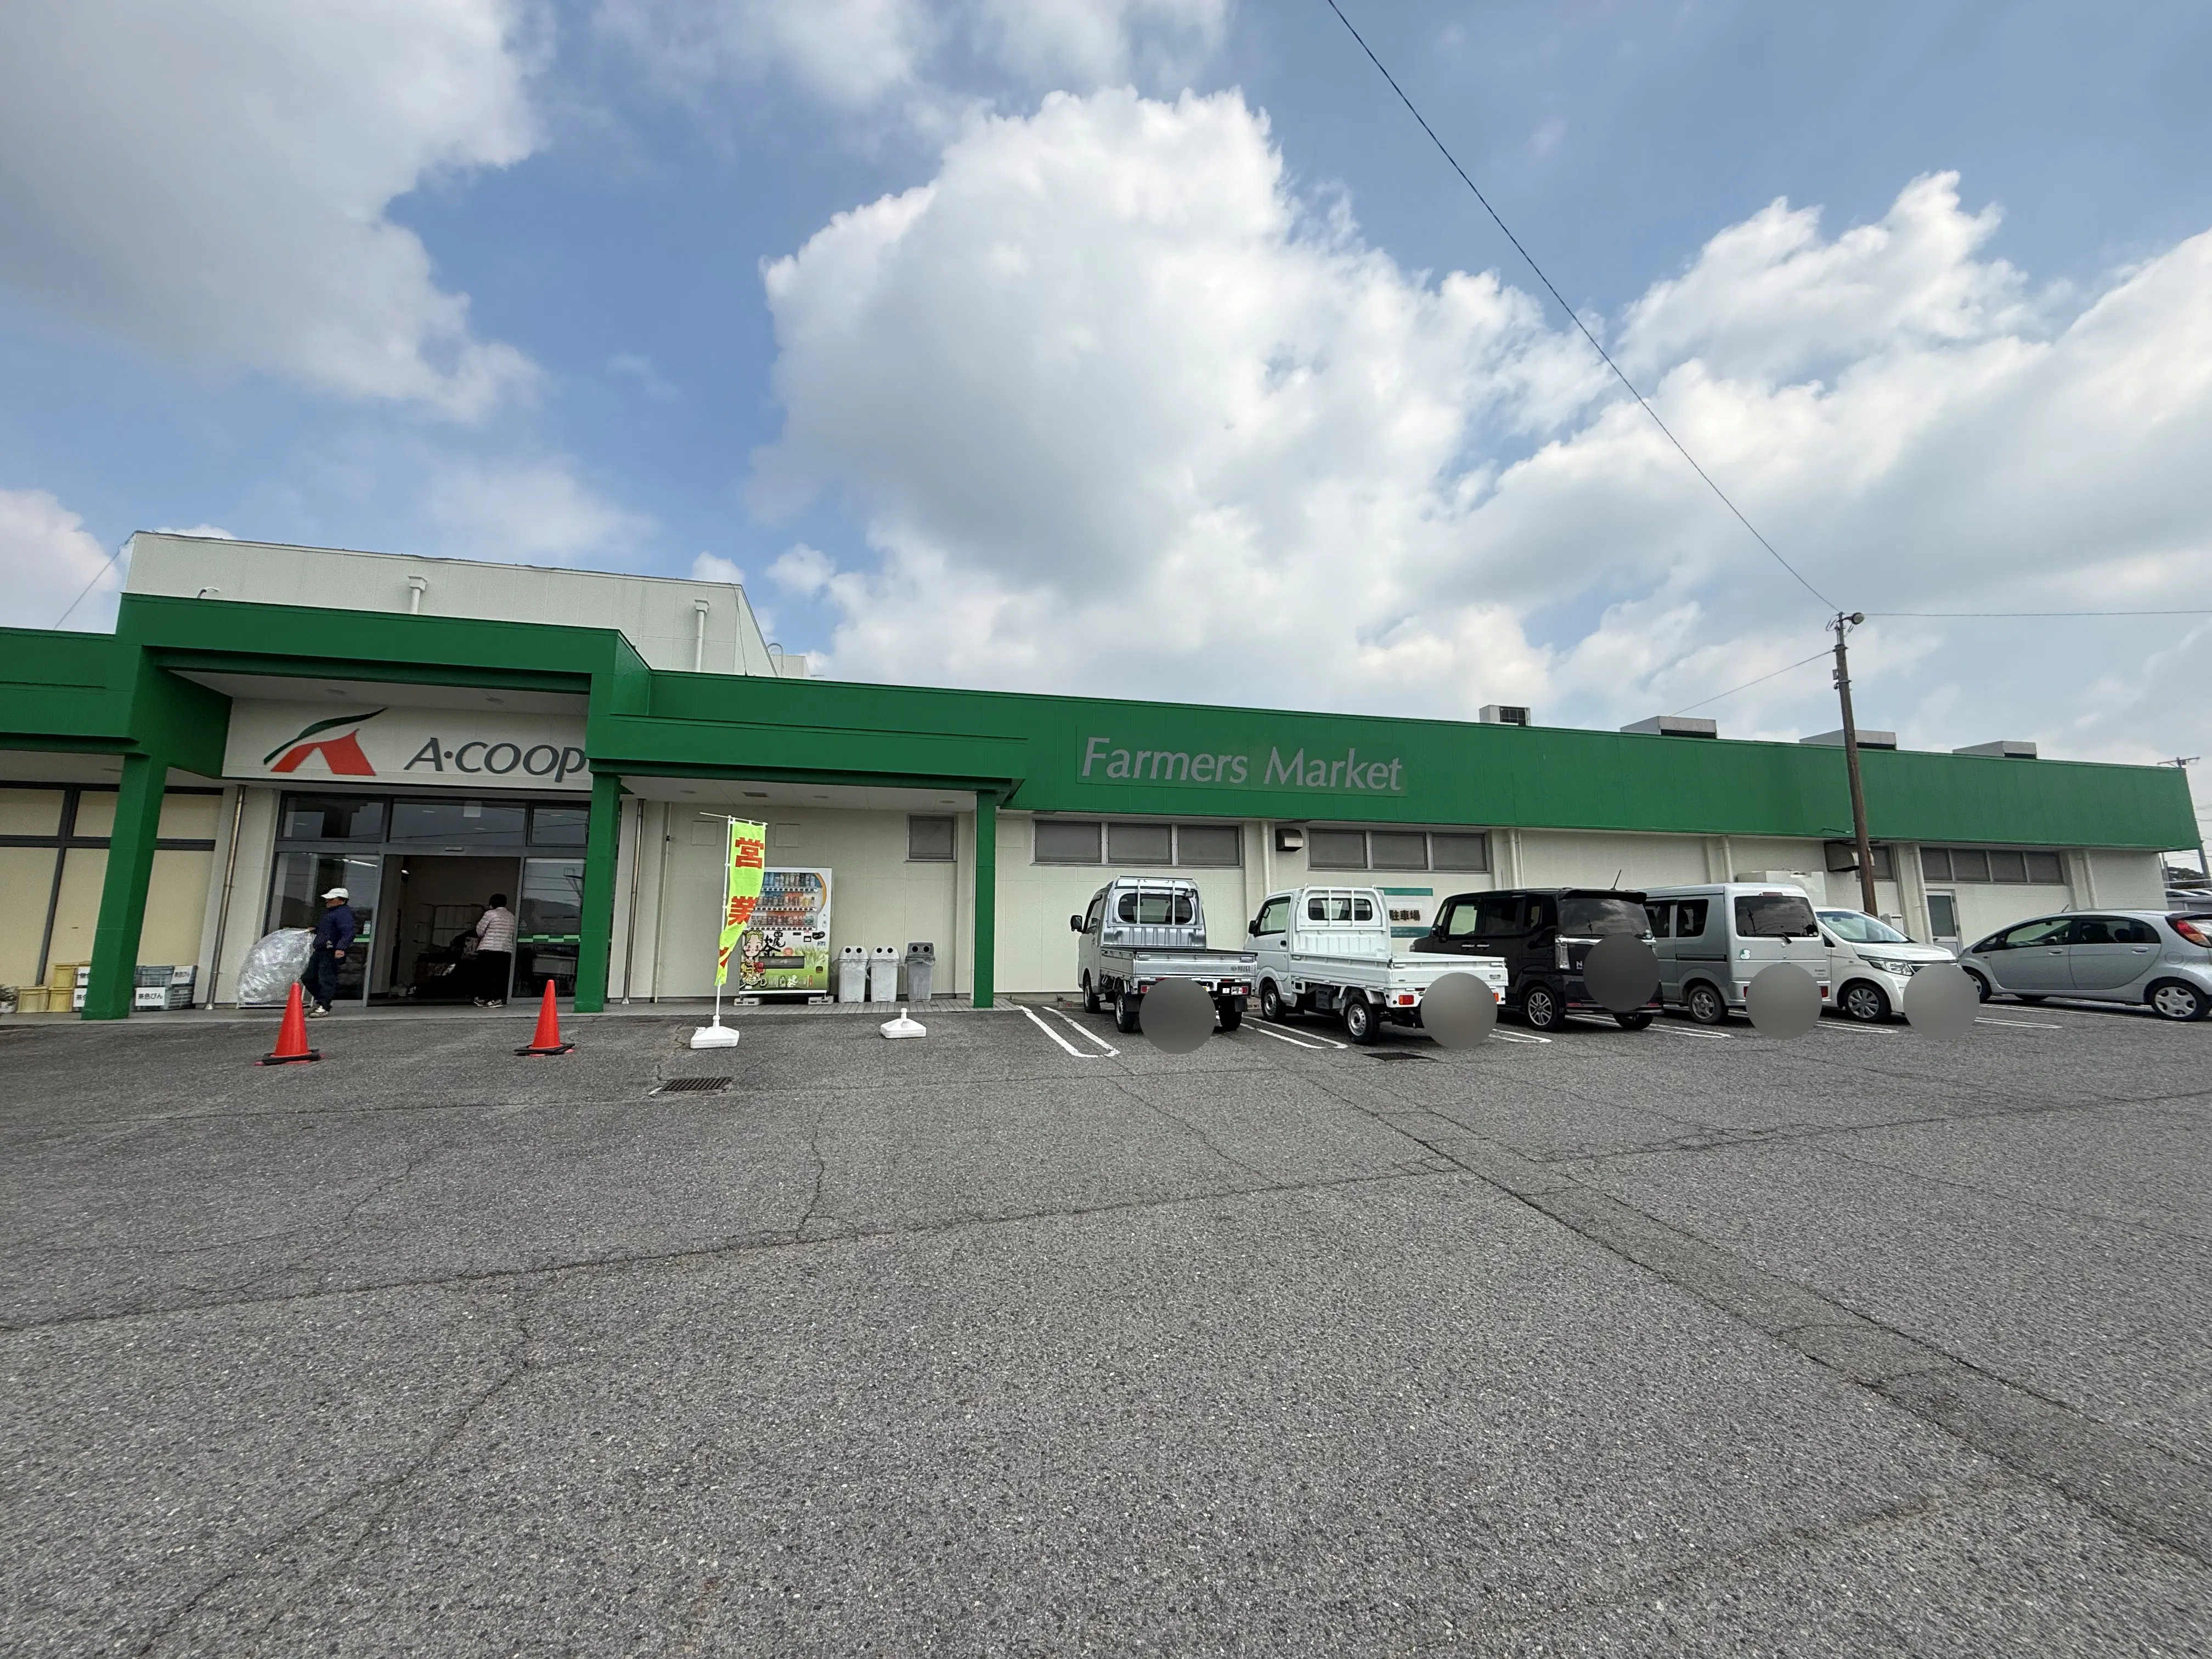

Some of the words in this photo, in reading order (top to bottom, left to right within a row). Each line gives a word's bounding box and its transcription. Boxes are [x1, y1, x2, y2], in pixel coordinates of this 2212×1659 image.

[1081, 736, 1248, 783] Farmers
[1263, 746, 1403, 791] Market
[719, 837, 764, 969] 営業
